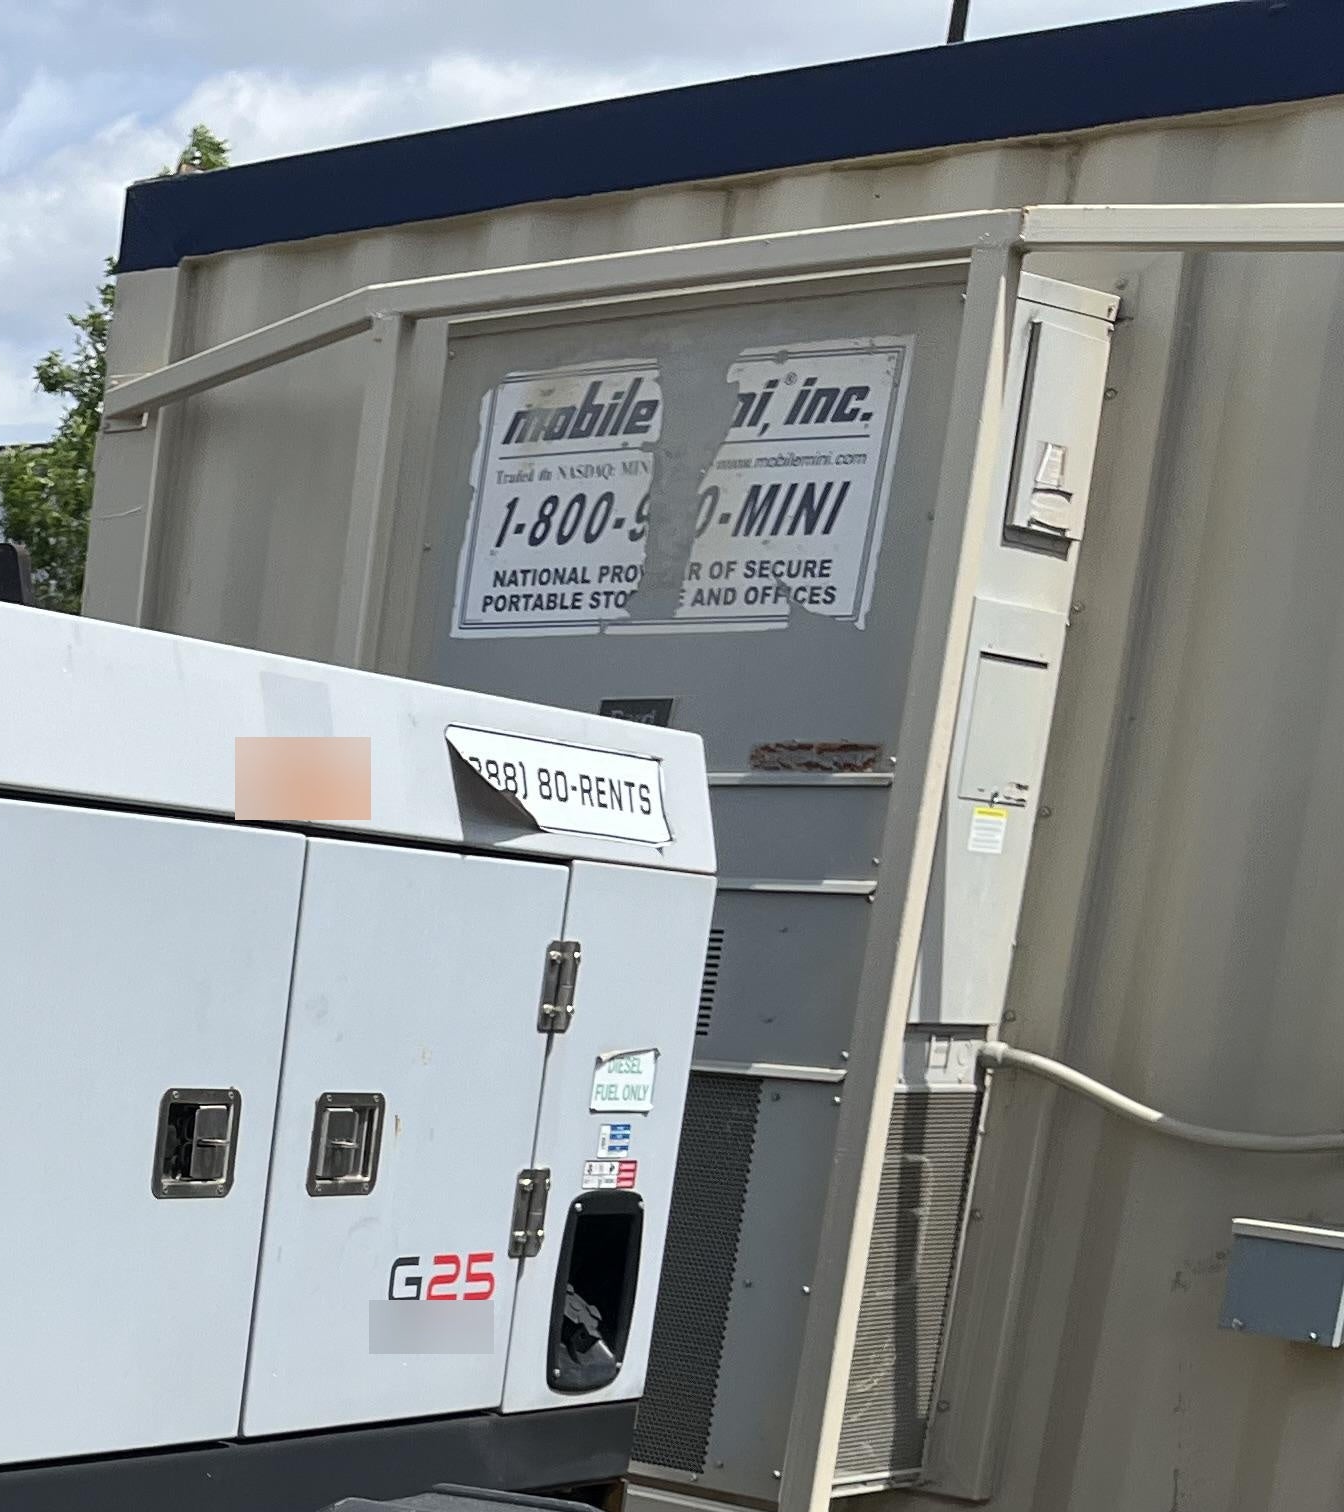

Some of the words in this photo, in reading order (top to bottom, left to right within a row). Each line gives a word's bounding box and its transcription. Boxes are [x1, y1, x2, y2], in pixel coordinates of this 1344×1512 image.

[501, 377, 659, 446] mobile
[783, 377, 873, 426] inc.
[492, 566, 591, 588] NATIONAL
[709, 560, 737, 580] OF
[743, 559, 833, 579] SECURE
[482, 591, 583, 613] PORTABLE
[691, 587, 737, 608] AND
[537, 767, 652, 816] 80-RENTS
[595, 1084, 620, 1101] FUEL
[622, 1084, 650, 1101] ONLY
[388, 1252, 495, 1301] G25
